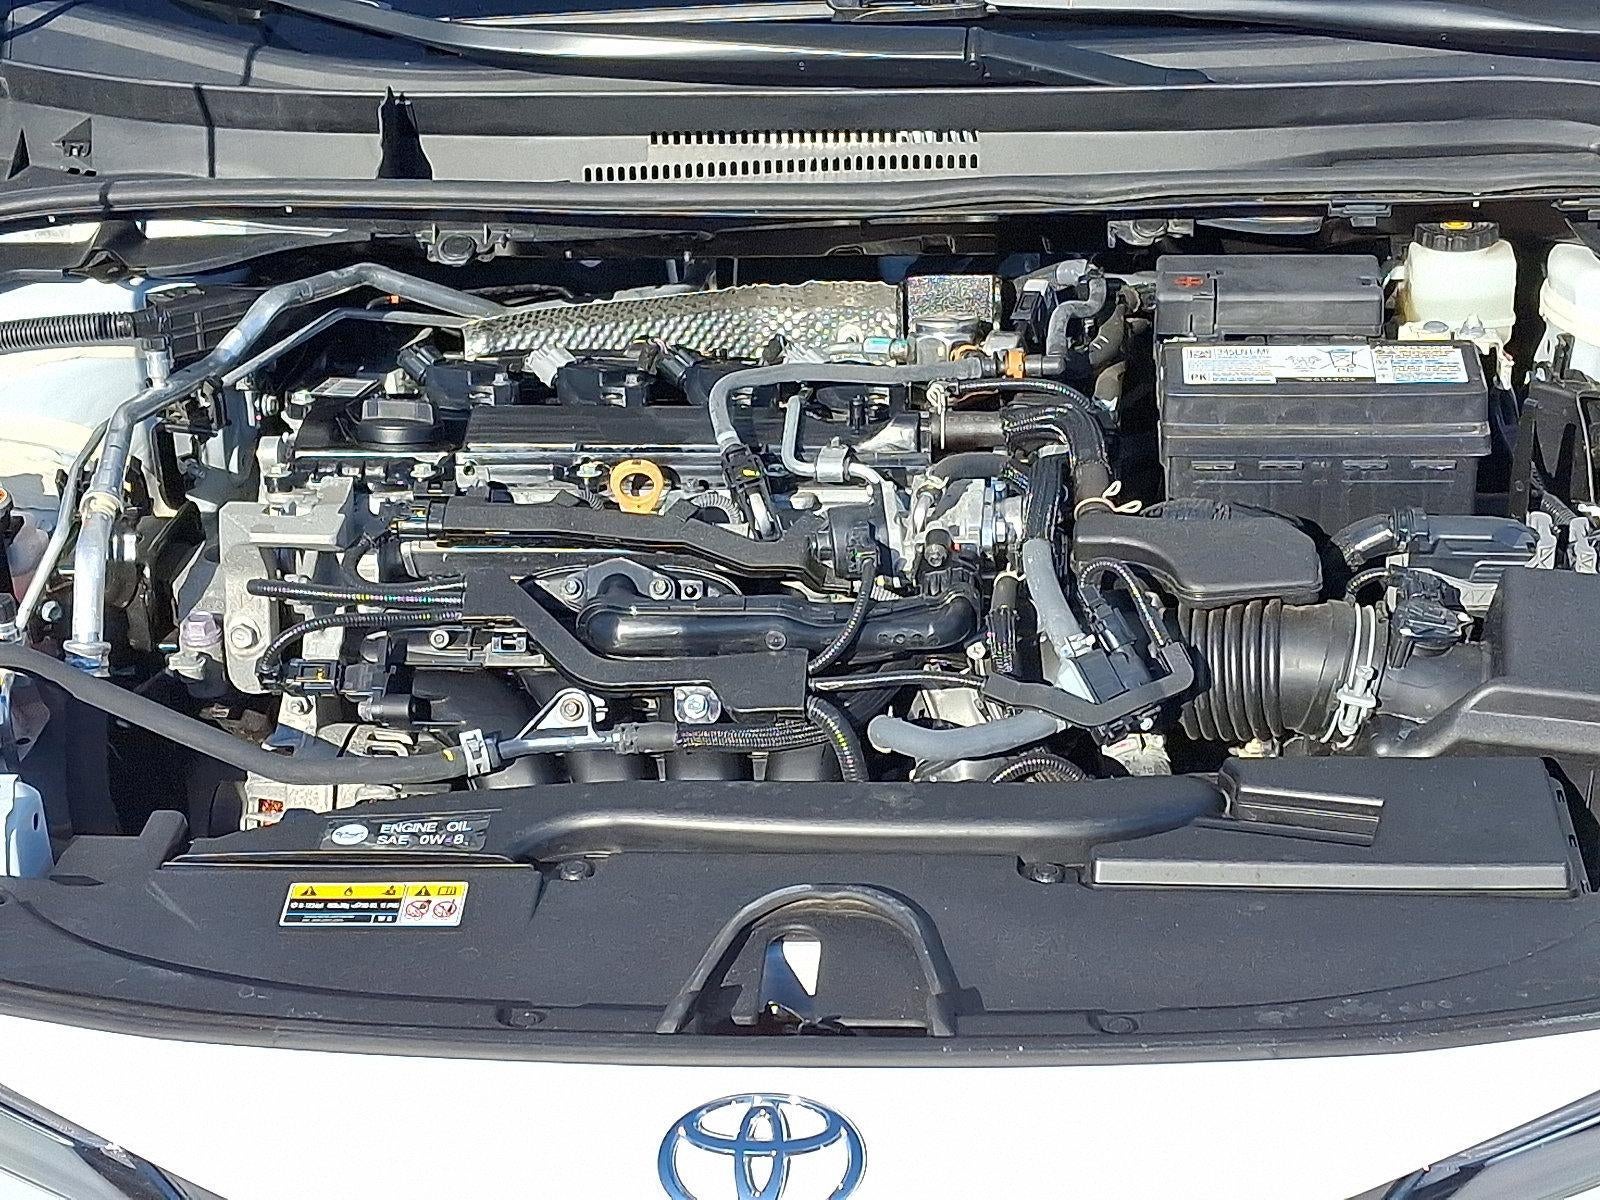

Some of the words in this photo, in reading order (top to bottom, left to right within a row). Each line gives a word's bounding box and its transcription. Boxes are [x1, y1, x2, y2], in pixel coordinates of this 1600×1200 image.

[379, 821, 438, 833] ENGINE
[446, 820, 472, 832] OIL
[376, 834, 410, 845] SAE
